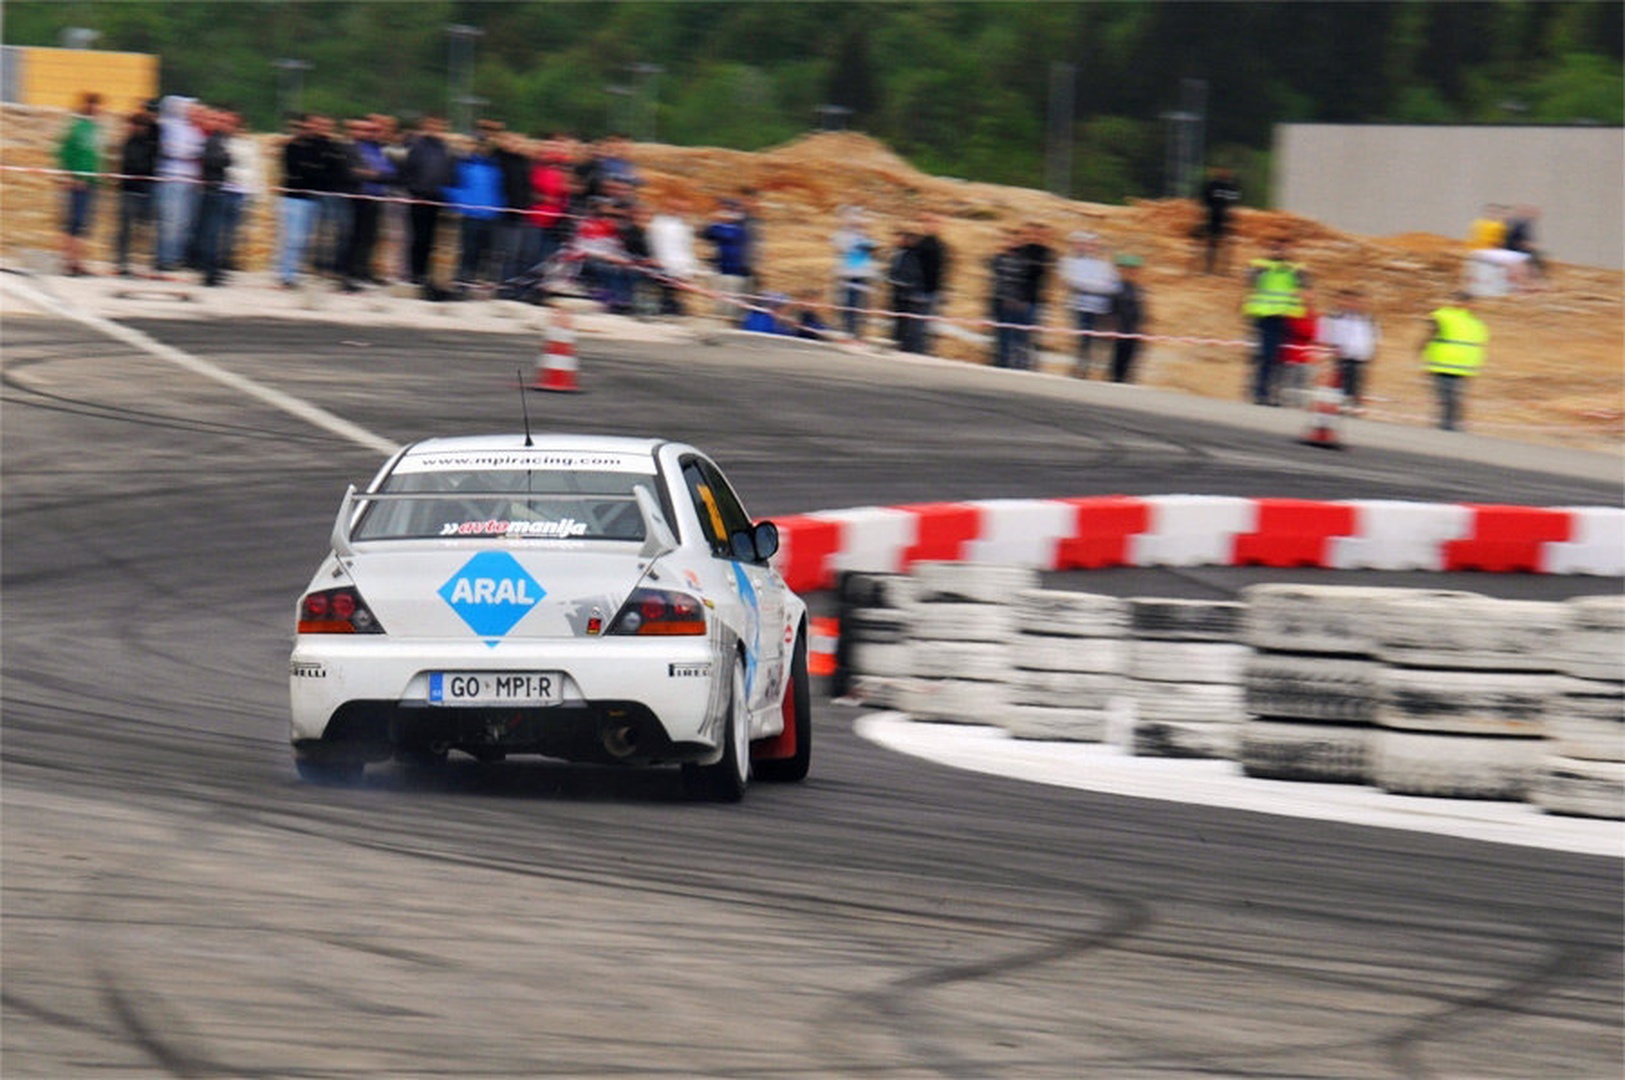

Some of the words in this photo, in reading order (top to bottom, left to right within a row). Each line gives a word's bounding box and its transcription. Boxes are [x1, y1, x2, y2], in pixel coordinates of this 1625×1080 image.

[422, 455, 621, 466] www.mpiracing.com
[450, 578, 535, 604] ARAL
[451, 676, 480, 697] GO
[495, 676, 551, 697] MPI-R
